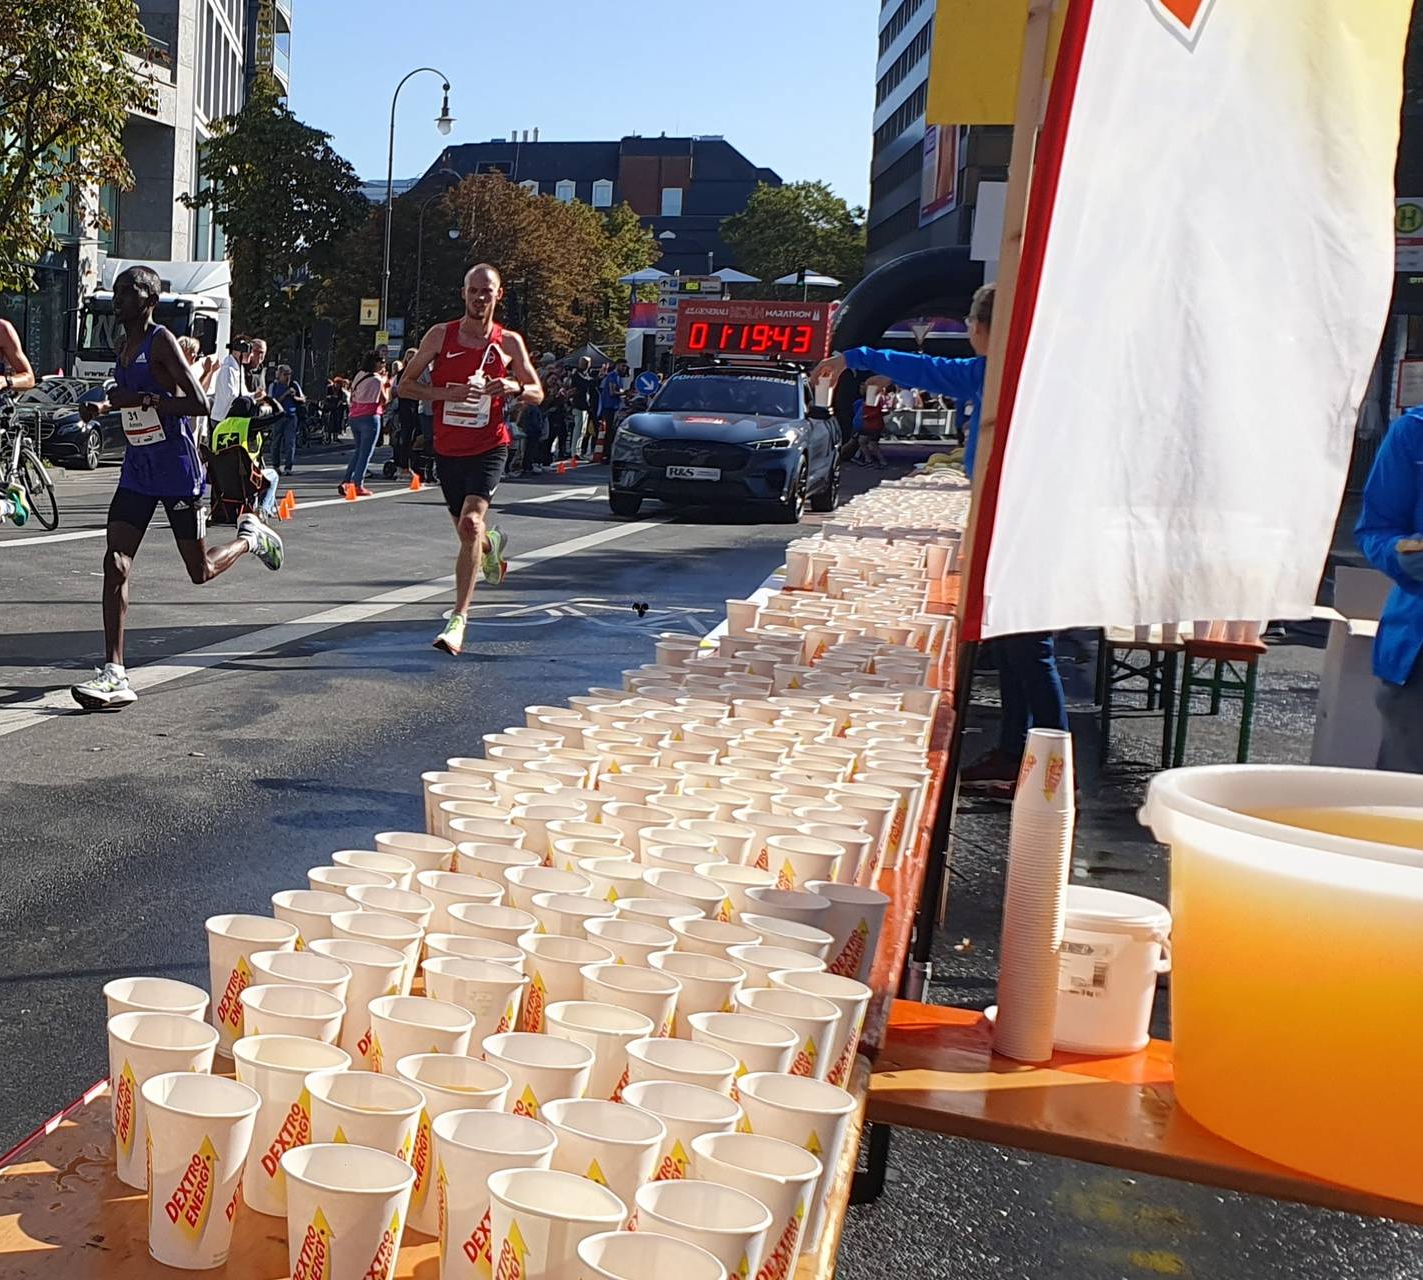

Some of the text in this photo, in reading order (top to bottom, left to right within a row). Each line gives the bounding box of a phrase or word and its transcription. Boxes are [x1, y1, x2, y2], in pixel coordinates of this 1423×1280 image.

[1400, 209, 1417, 227] H
[766, 310, 811, 319] MARATHON
[127, 411, 138, 421] 31
[669, 467, 695, 477] R&S
[218, 969, 239, 1023] DEXTRO
[120, 1083, 131, 1144] ENERGY
[261, 1103, 301, 1178] DEXTRO
[165, 1153, 201, 1224] DEXTRO
[185, 1161, 210, 1229] ENERGY
